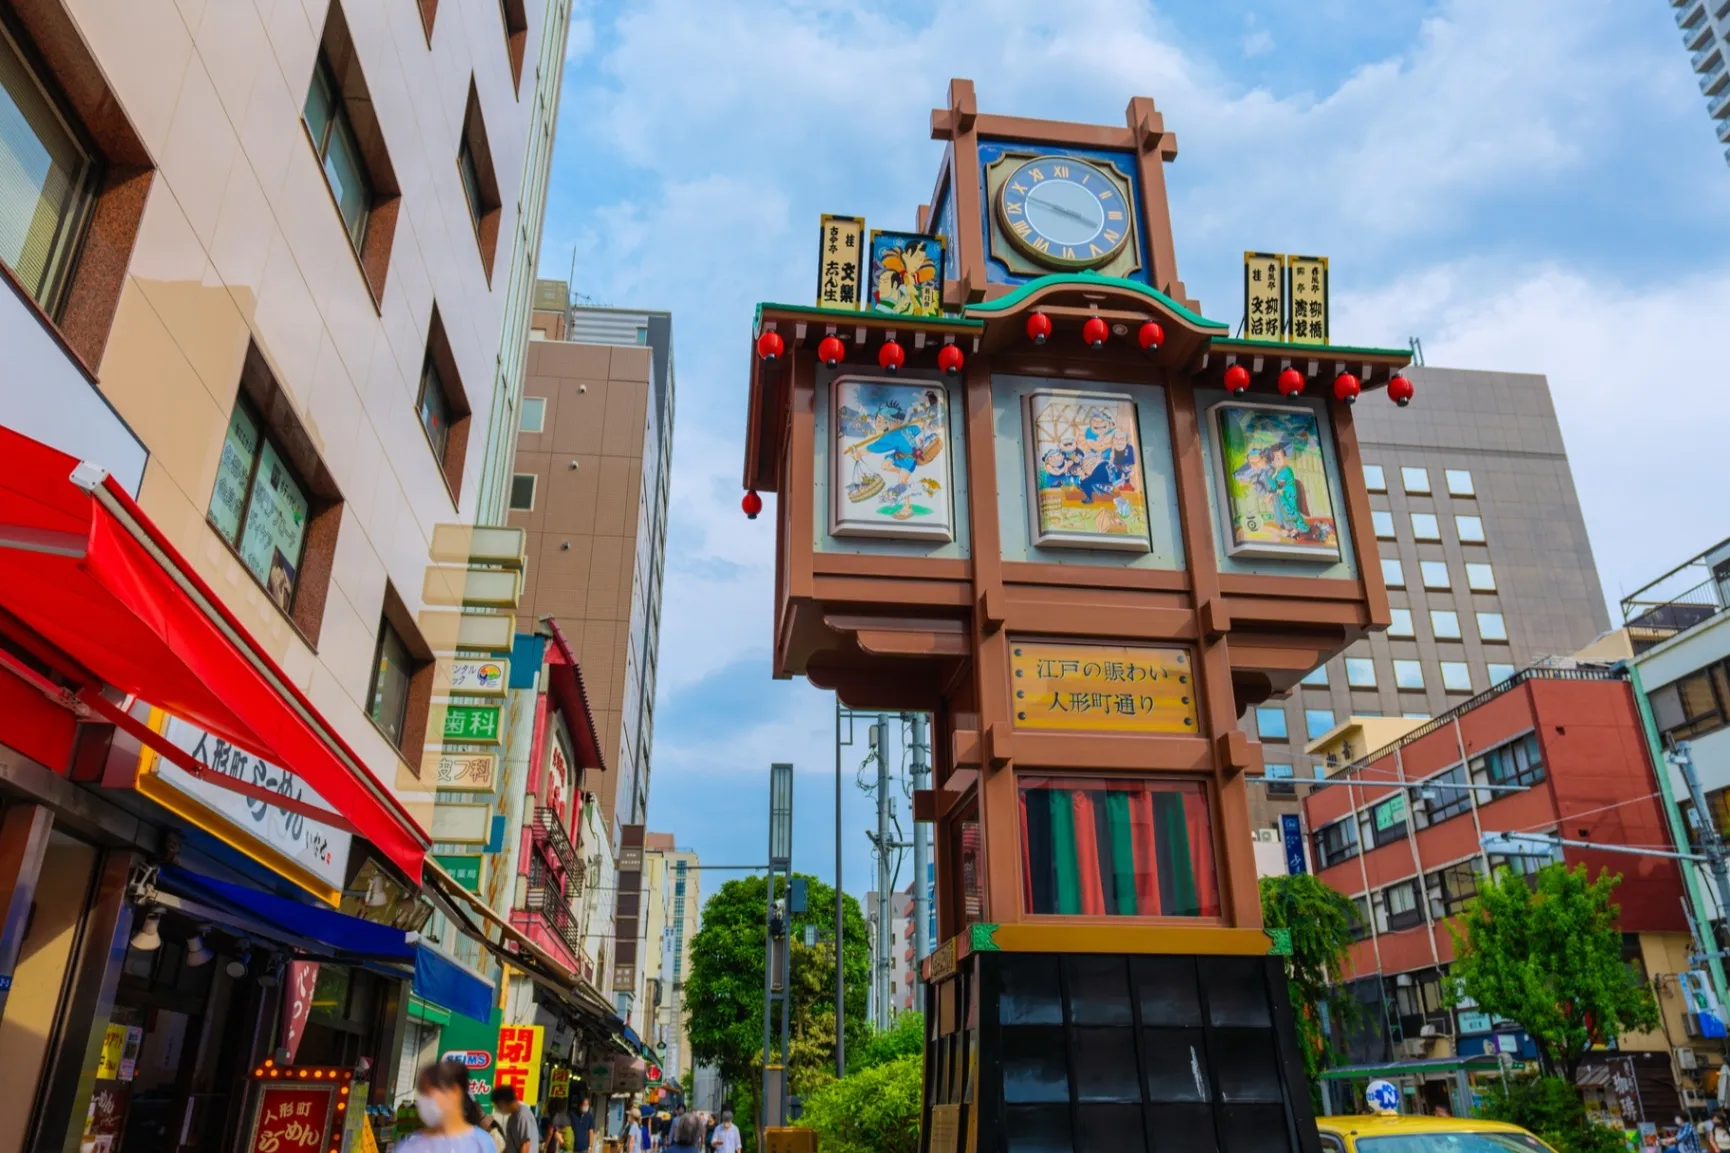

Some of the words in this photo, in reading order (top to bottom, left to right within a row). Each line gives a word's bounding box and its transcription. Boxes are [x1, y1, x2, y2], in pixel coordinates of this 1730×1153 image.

[1028, 167, 1045, 183] XI
[1053, 165, 1069, 179] XII
[1082, 174, 1091, 185] I
[1011, 181, 1028, 196] X
[1099, 189, 1113, 200] II
[1007, 201, 1022, 215] IX
[1032, 236, 1050, 254] VII
[1089, 243, 1104, 259] V
[1062, 246, 1076, 260] VI
[1037, 658, 1169, 682] 江戸の賑わい
[1048, 691, 1154, 716] 人形町通り
[495, 1028, 534, 1102] 閉店
